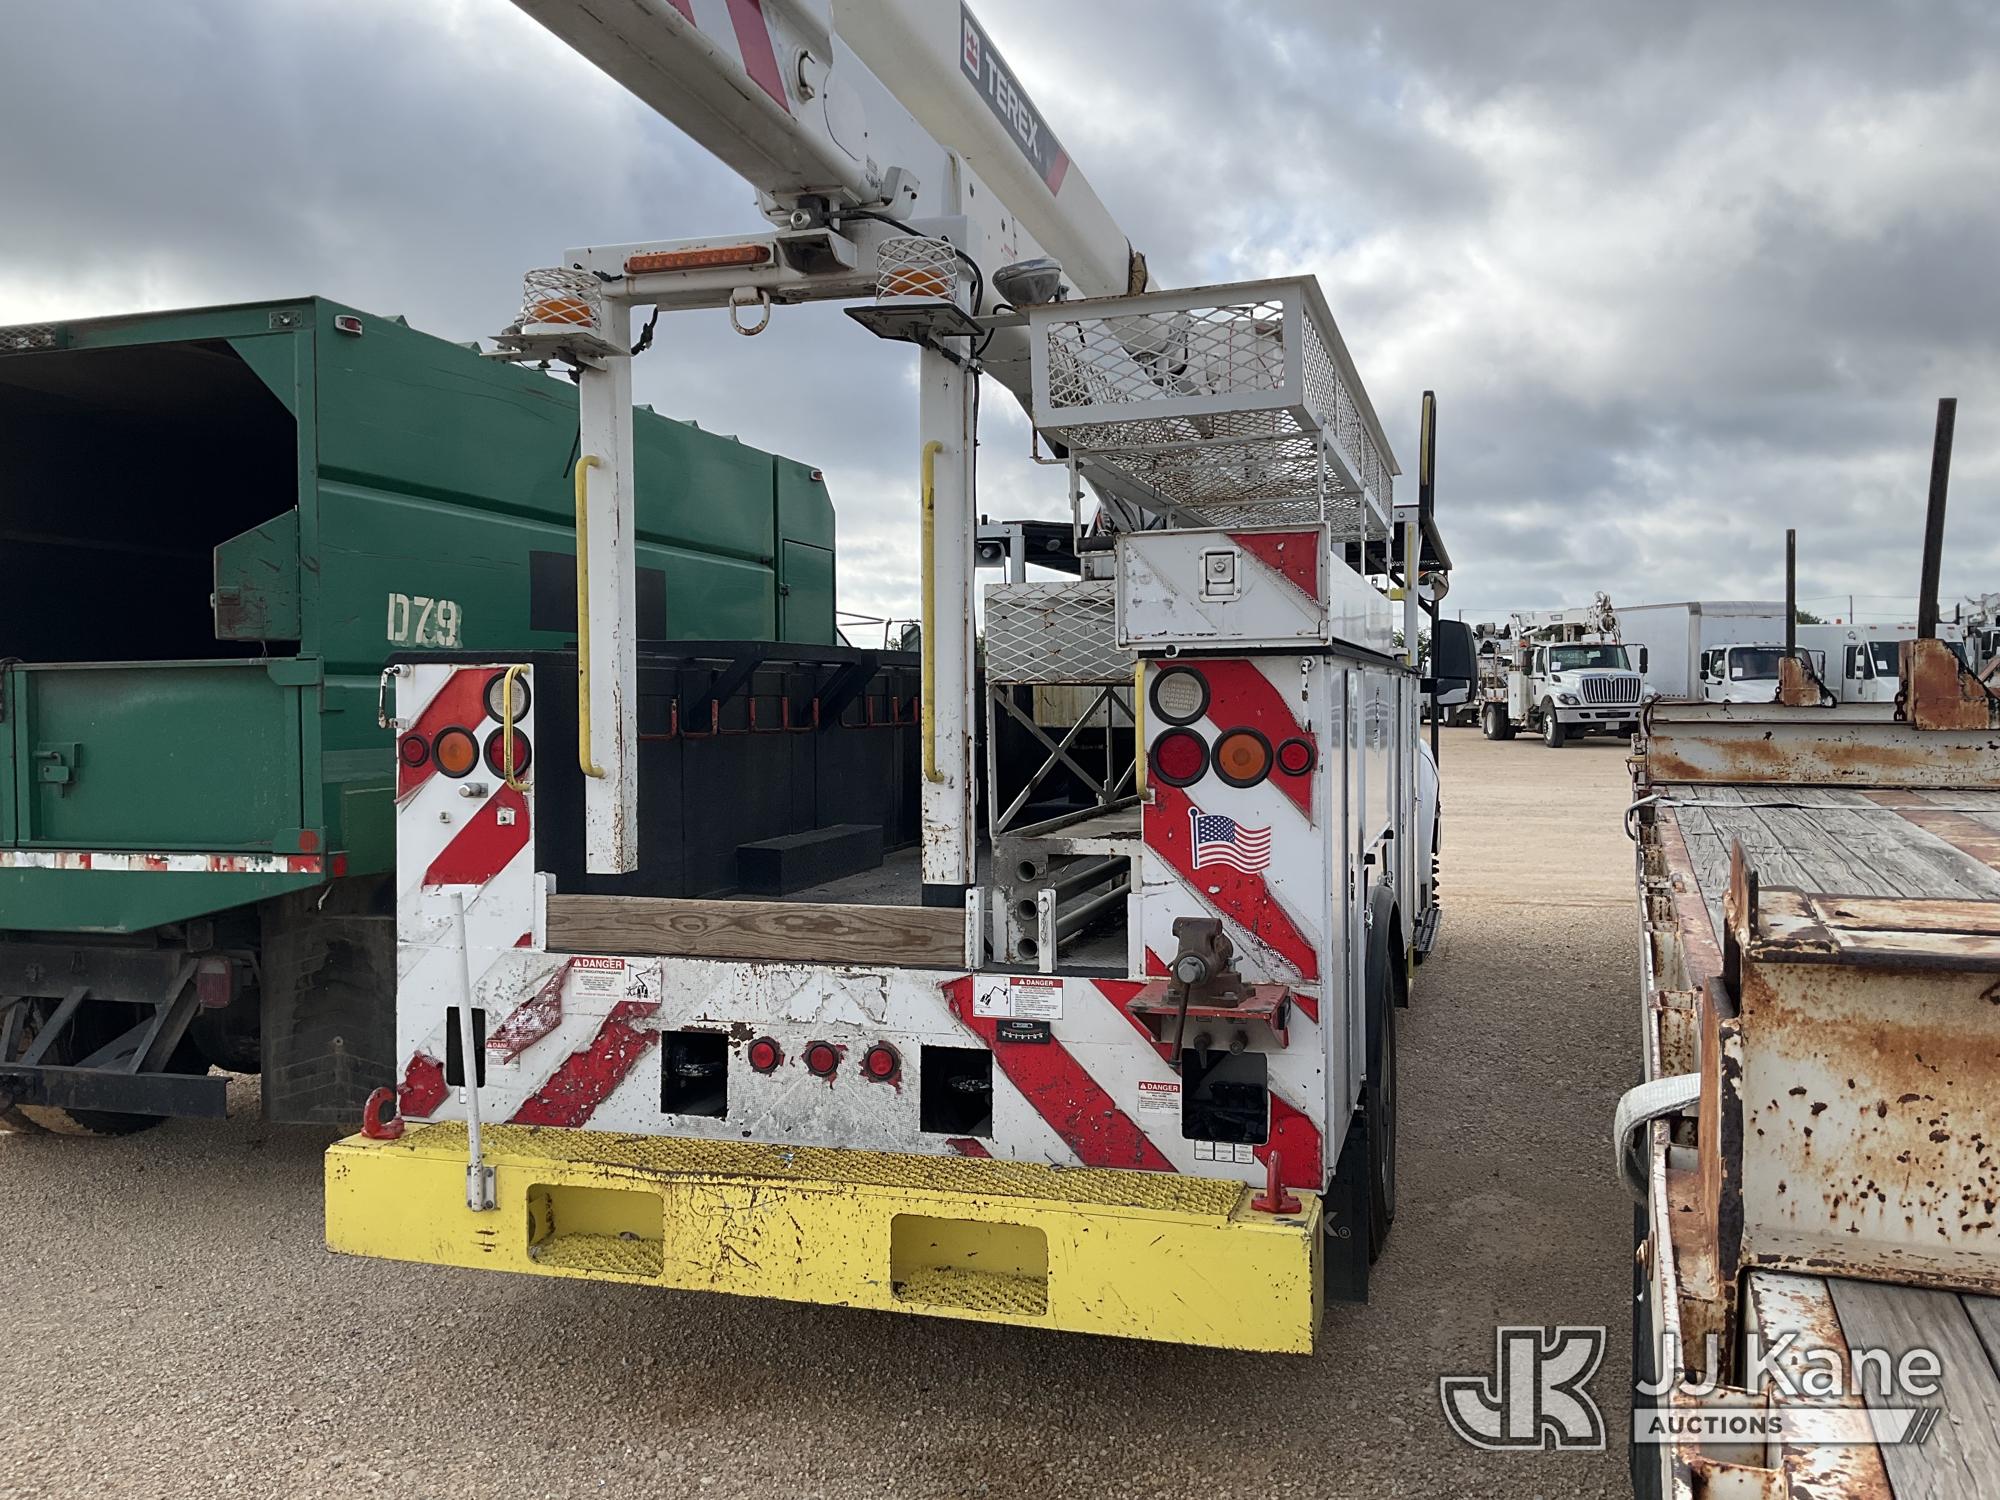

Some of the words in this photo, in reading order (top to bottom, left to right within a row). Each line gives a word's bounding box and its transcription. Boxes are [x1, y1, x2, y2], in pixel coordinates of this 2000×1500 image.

[985, 51, 1038, 158] TEREX
[387, 593, 457, 646] D79
[582, 958, 622, 969] DANGER
[1026, 979, 1054, 987] DANGER
[1147, 1083, 1179, 1092] DANGER
